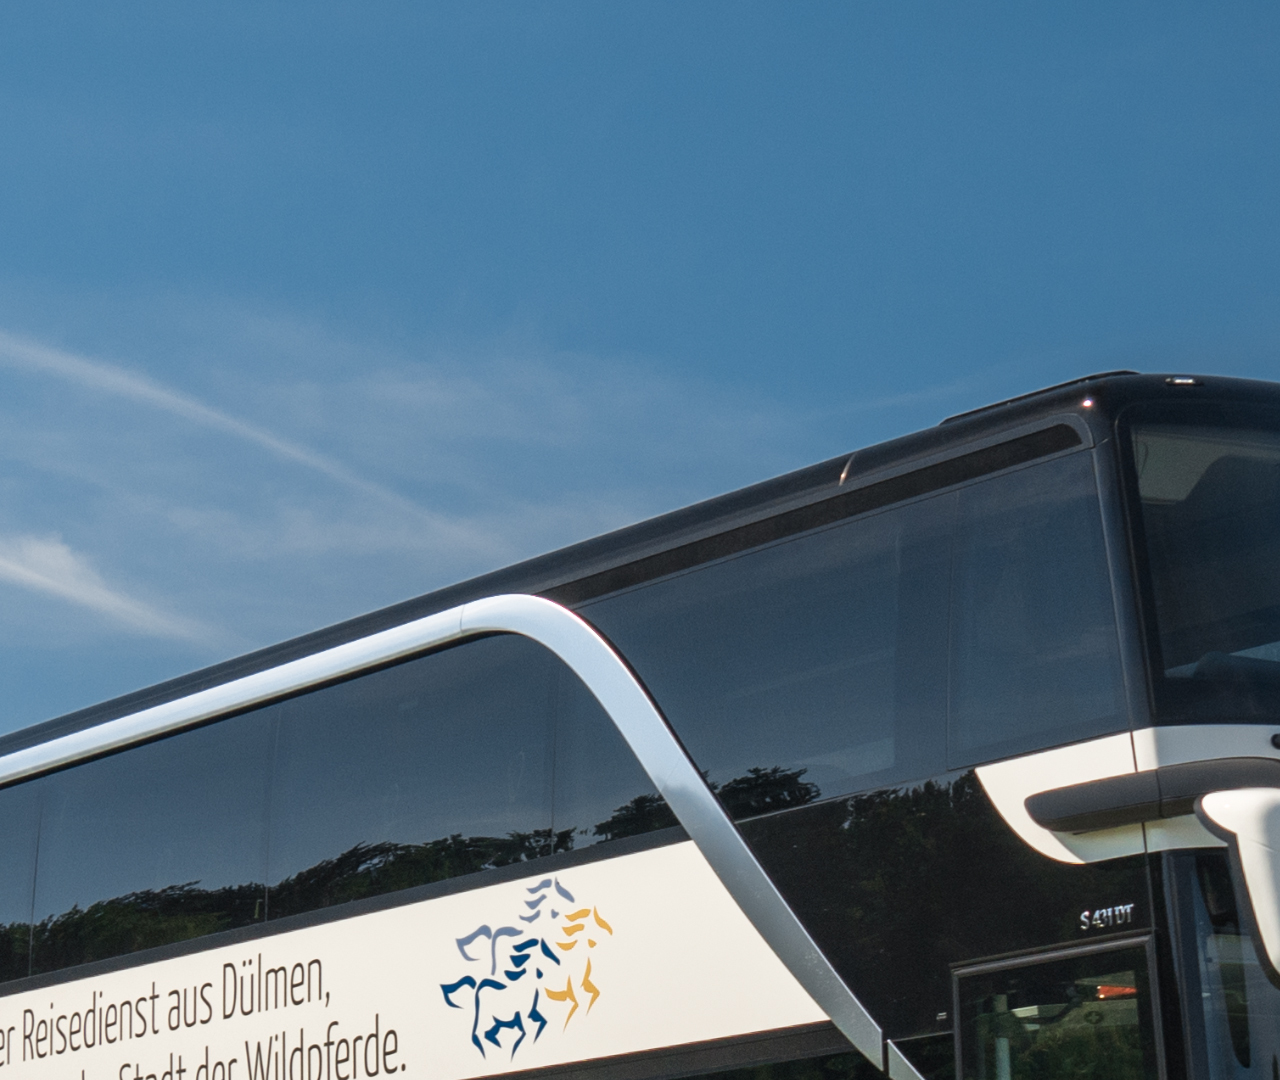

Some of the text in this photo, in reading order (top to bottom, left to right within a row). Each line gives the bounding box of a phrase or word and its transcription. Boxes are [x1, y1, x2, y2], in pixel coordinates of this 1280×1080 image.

[1080, 911, 1090, 930] S
[1092, 907, 1114, 928] 431
[22, 982, 160, 1062] Reisedienst
[167, 975, 213, 1031] aus
[222, 953, 331, 1023] Dülmen,
